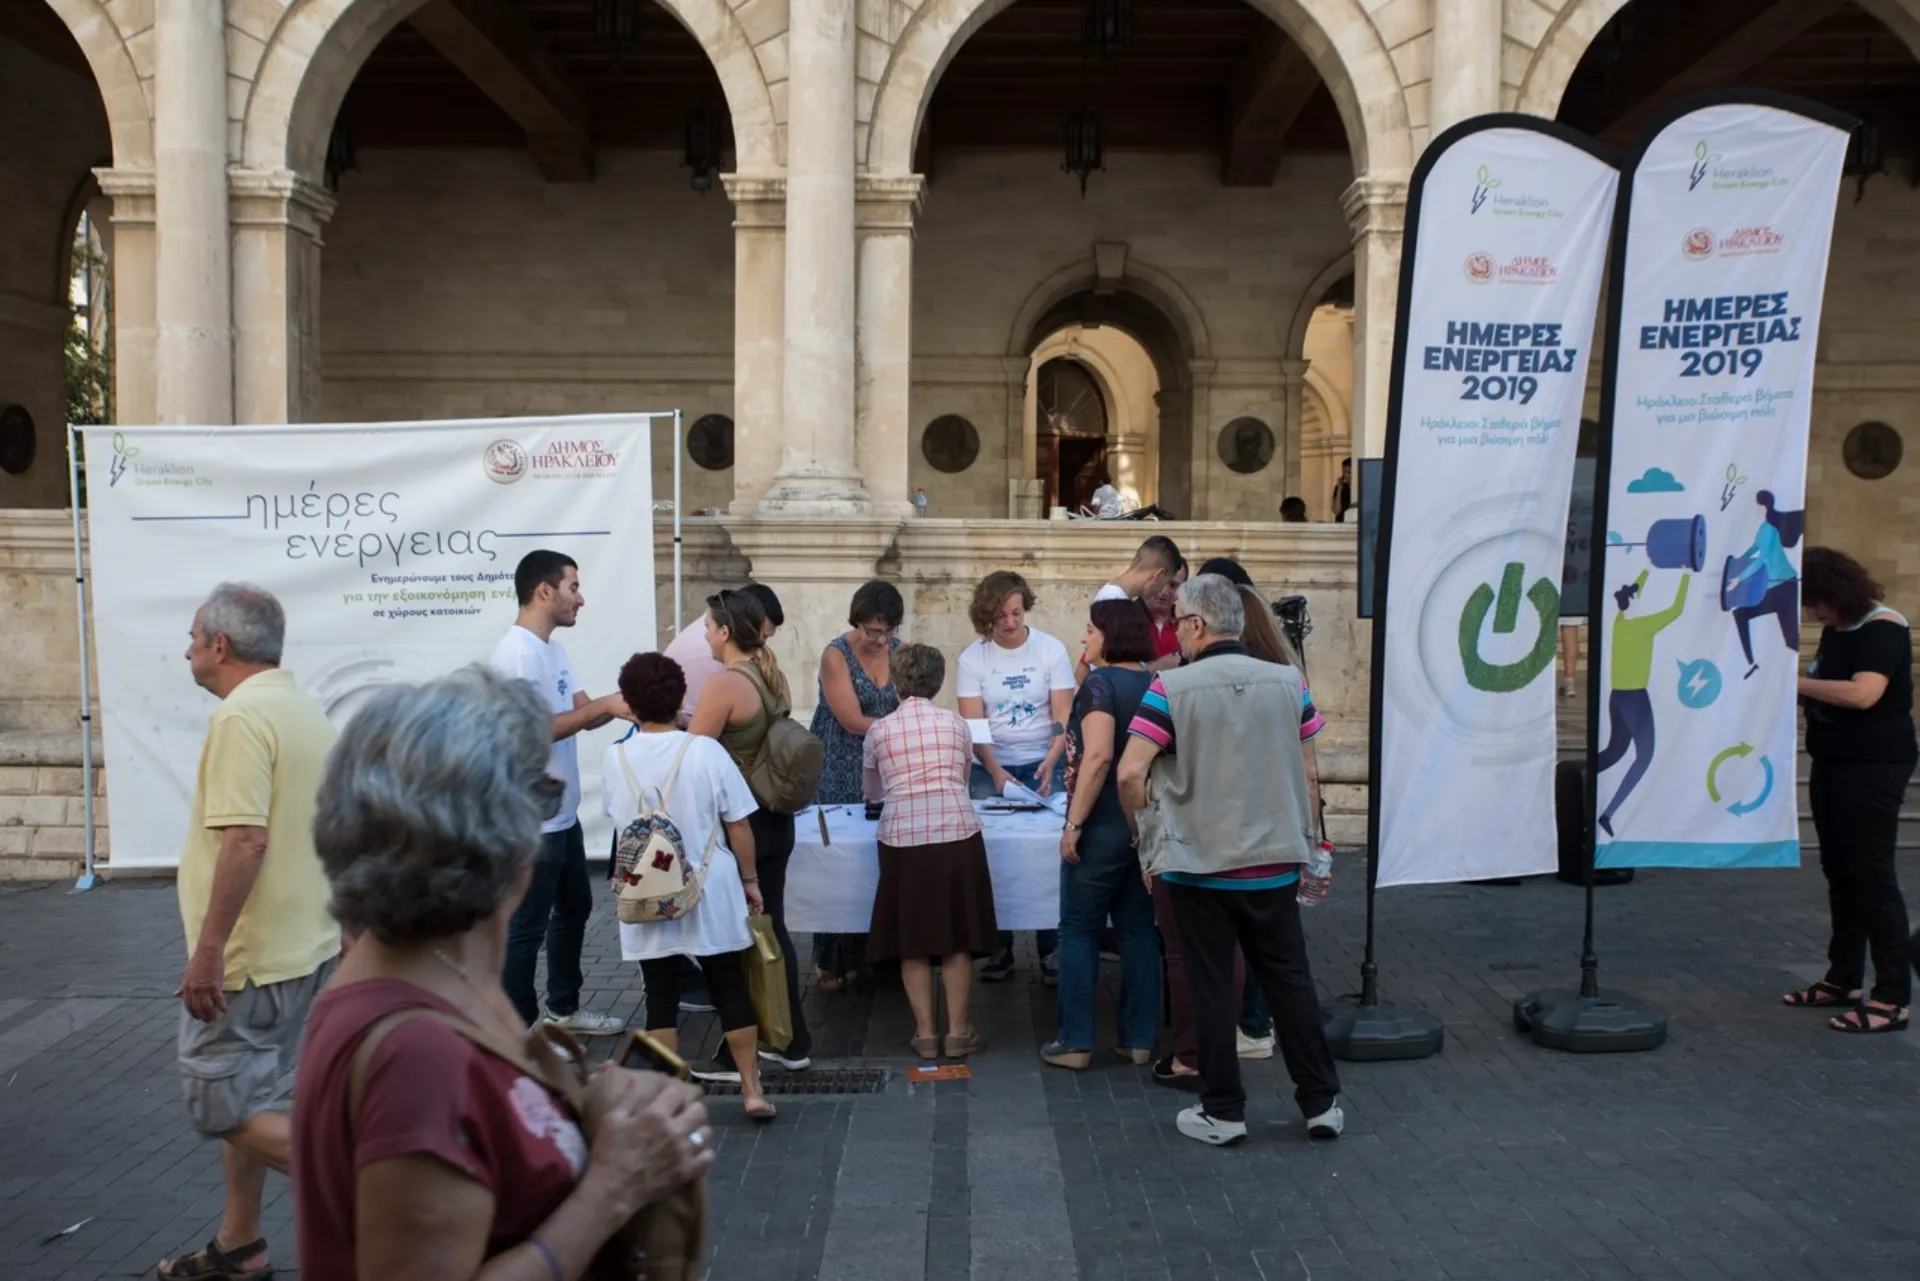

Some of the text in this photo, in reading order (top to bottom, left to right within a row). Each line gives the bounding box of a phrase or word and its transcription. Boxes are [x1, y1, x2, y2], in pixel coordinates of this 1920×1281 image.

[1493, 194, 1549, 207] Heraklion
[1663, 291, 1789, 323] ΗΜΕΡΕΣ
[1446, 320, 1562, 347] ΗΜΕΡΕΣ
[1639, 316, 1802, 349] ΕΝΕΡΓΕΙΑΣ
[1423, 346, 1577, 373] ΕΝΕΡΓΕΙΑΣ
[1679, 348, 1763, 378] 2019
[1459, 375, 1538, 405] 2019
[547, 440, 604, 454] ΔΗΜΟΣ
[1437, 436, 1455, 446] για
[1458, 436, 1478, 447] μια
[134, 462, 195, 475] Heraklion
[532, 453, 618, 468] ΗΡΑΚΛΕΙΟΥ
[163, 477, 193, 487] Energy
[195, 477, 213, 488] City
[246, 480, 400, 529] ημέρες
[286, 520, 498, 568] ενέργειας
[371, 571, 516, 585] Ενημερώνουμε τους Δημότε
[342, 593, 363, 604] για
[368, 592, 388, 604] την
[392, 588, 486, 602] εξοικονόμηση
[388, 608, 428, 619] χώρους
[430, 606, 482, 616] κατοικιών
